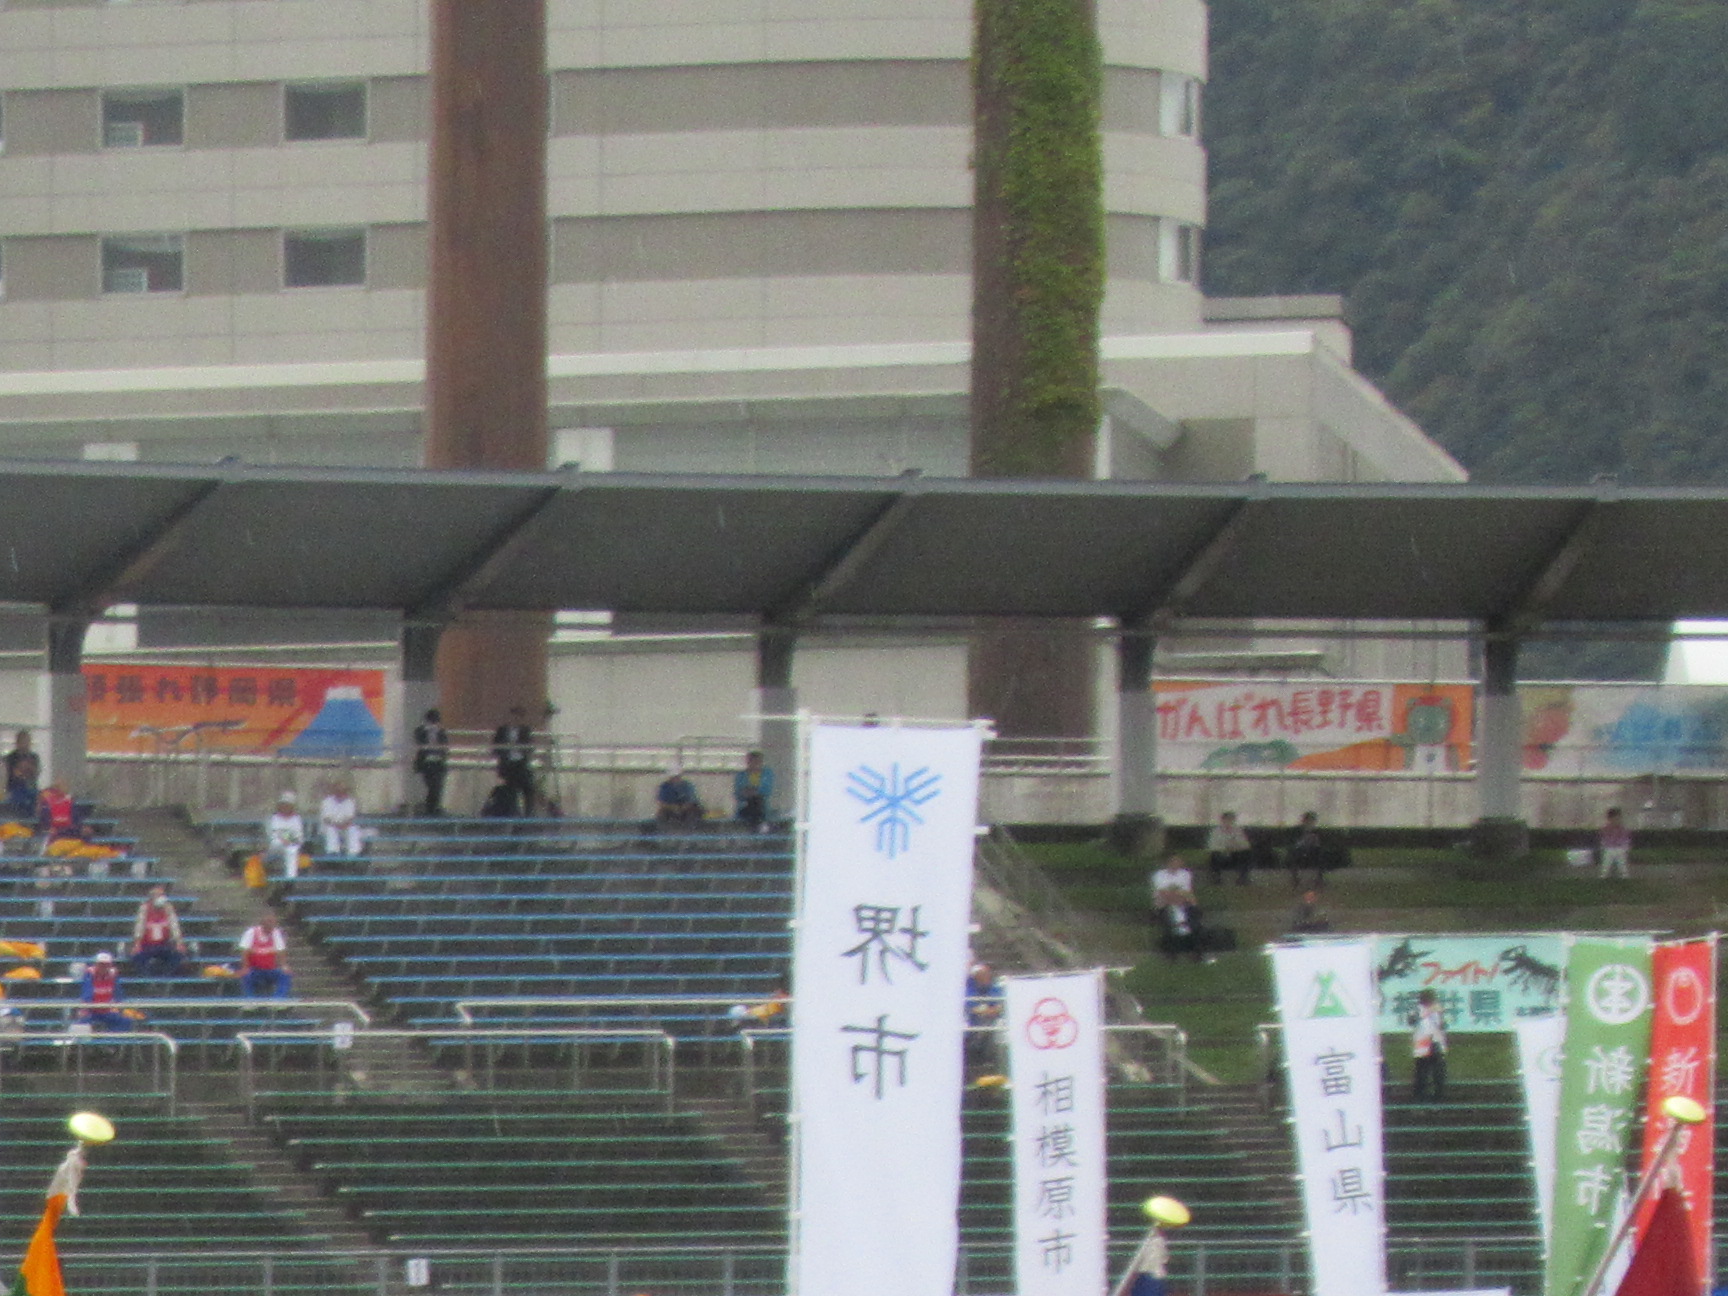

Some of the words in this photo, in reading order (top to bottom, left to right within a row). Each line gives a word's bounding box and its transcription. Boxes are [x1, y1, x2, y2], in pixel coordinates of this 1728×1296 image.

[1156, 689, 1384, 740] がんばれ長野県
[1034, 1071, 1078, 1274] 相模原市
[1314, 1047, 1374, 1215] 富山県
